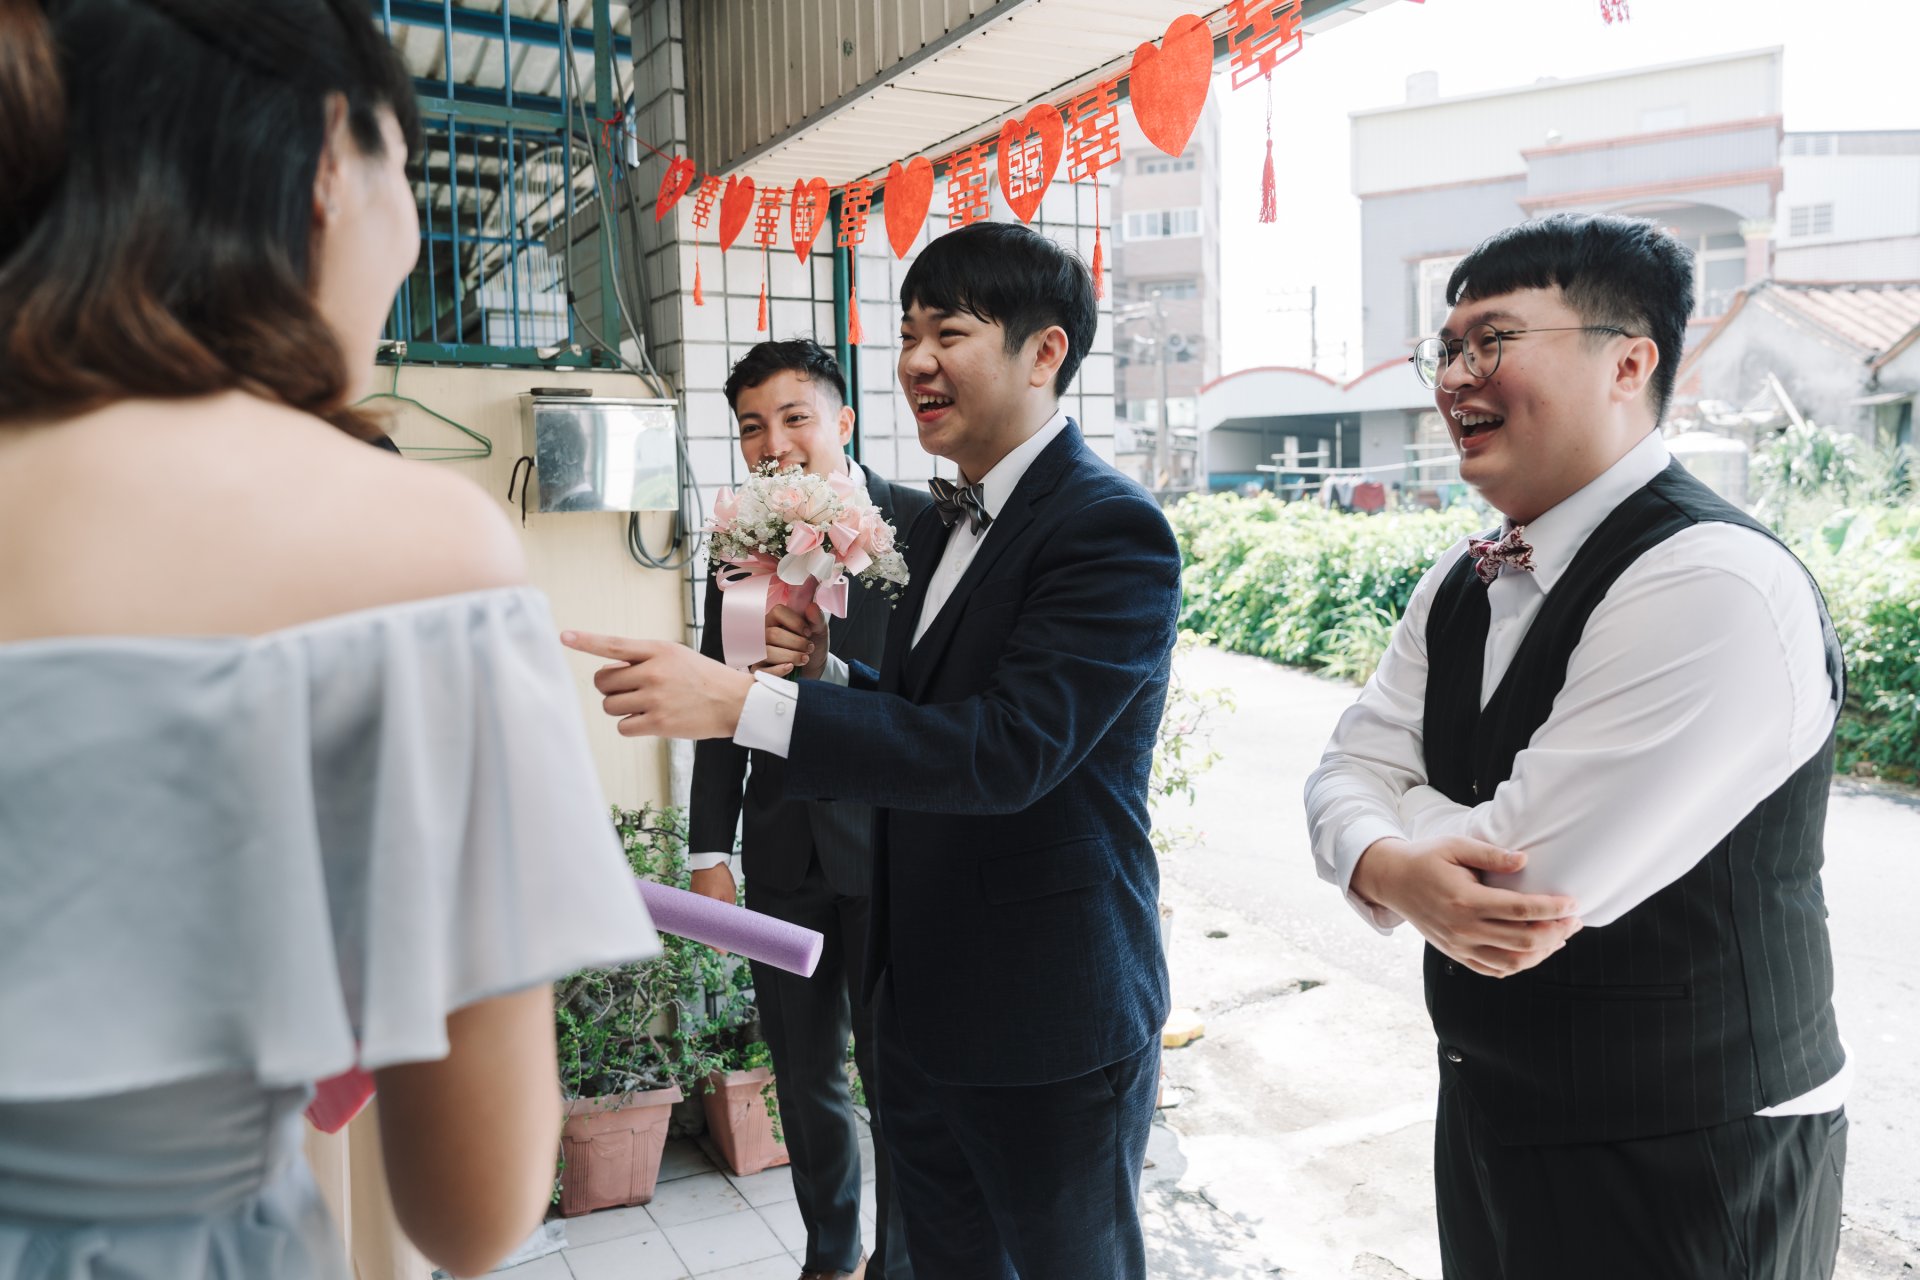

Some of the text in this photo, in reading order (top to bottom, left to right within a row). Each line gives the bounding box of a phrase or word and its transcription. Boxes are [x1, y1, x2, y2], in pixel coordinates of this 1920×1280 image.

[1008, 126, 1044, 200] 囍
[1067, 81, 1121, 184] 囍
[754, 186, 786, 245] 囍
[794, 190, 817, 242] 囍
[837, 178, 874, 248] 囍
[945, 144, 990, 229] 囍
